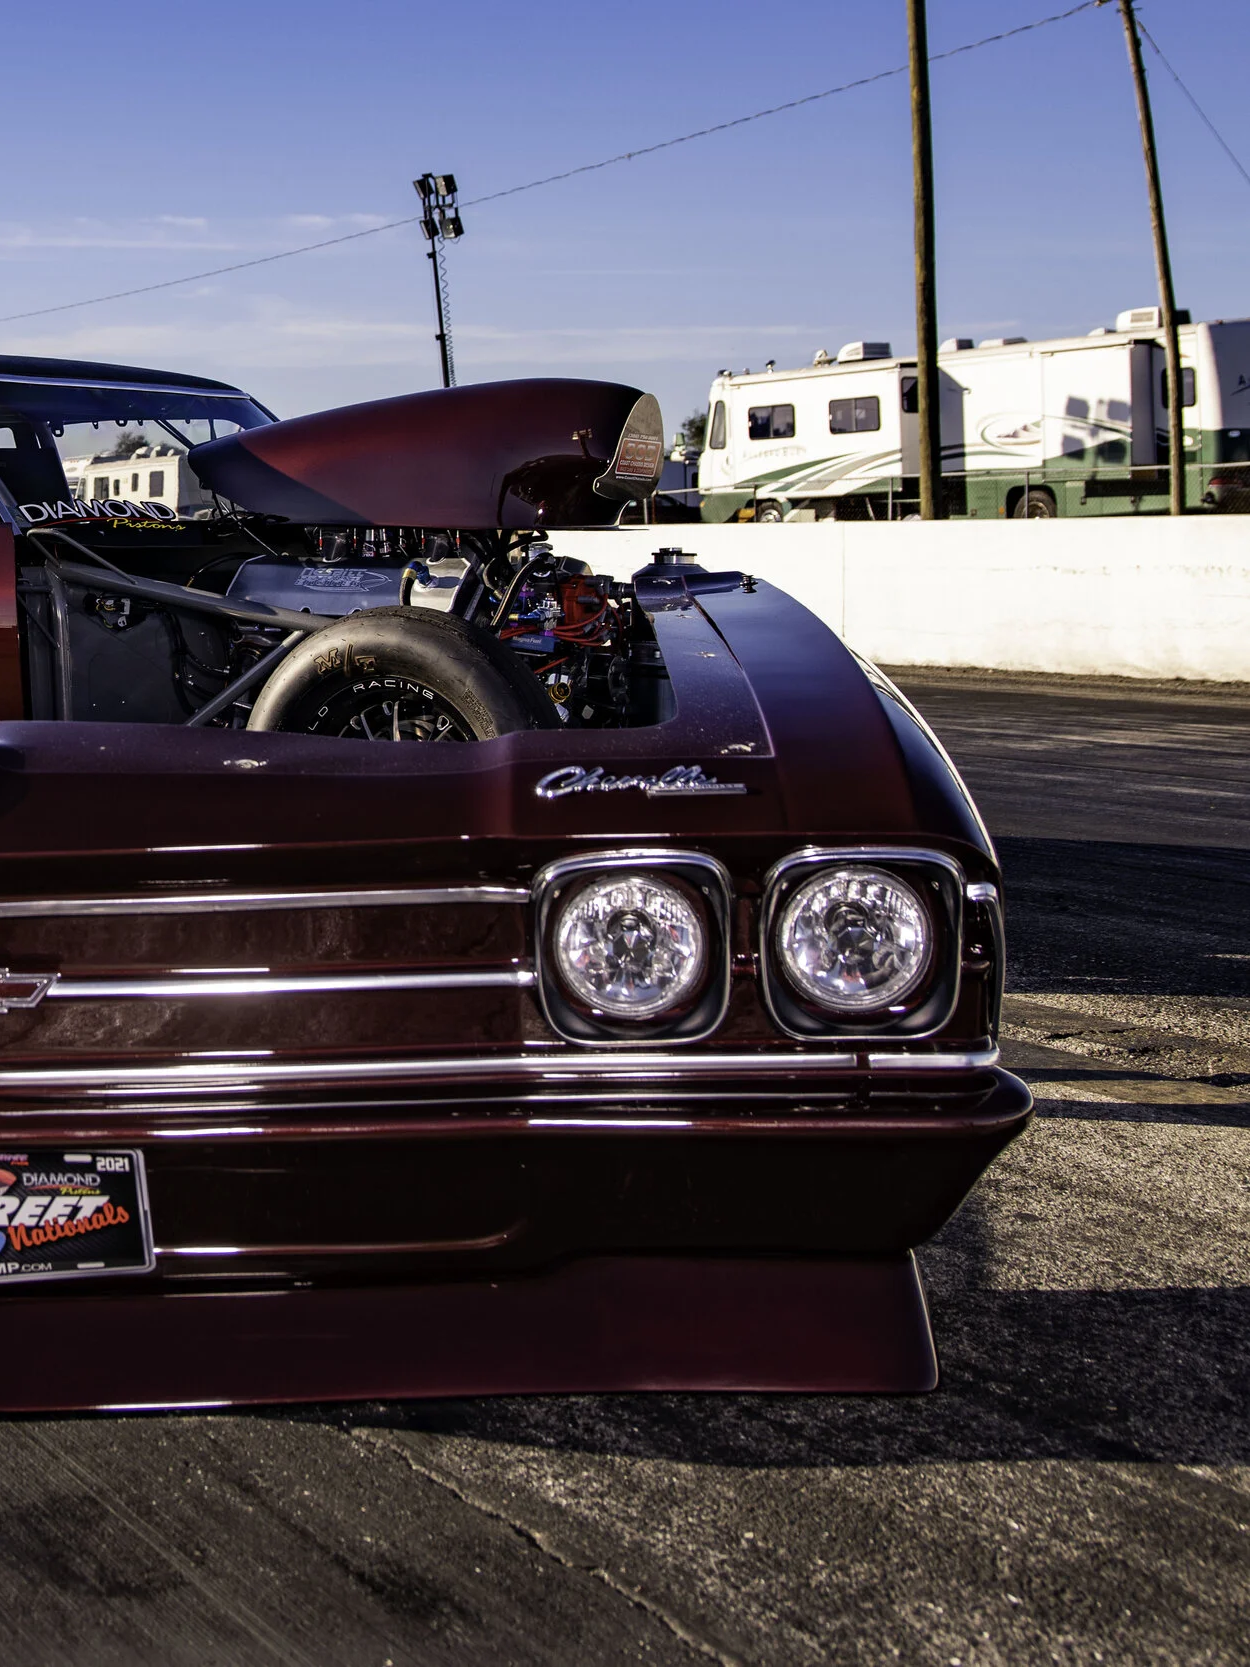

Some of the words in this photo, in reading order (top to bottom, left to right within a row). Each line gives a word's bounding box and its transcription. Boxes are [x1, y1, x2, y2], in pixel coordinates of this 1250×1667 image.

[19, 500, 176, 523] DIAMOND
[107, 517, 186, 530] Pistons
[352, 679, 435, 701] RACING
[96, 1156, 130, 1172] 2021
[22, 1172, 101, 1187] DIAMOND
[7, 1202, 130, 1252] Nationals
